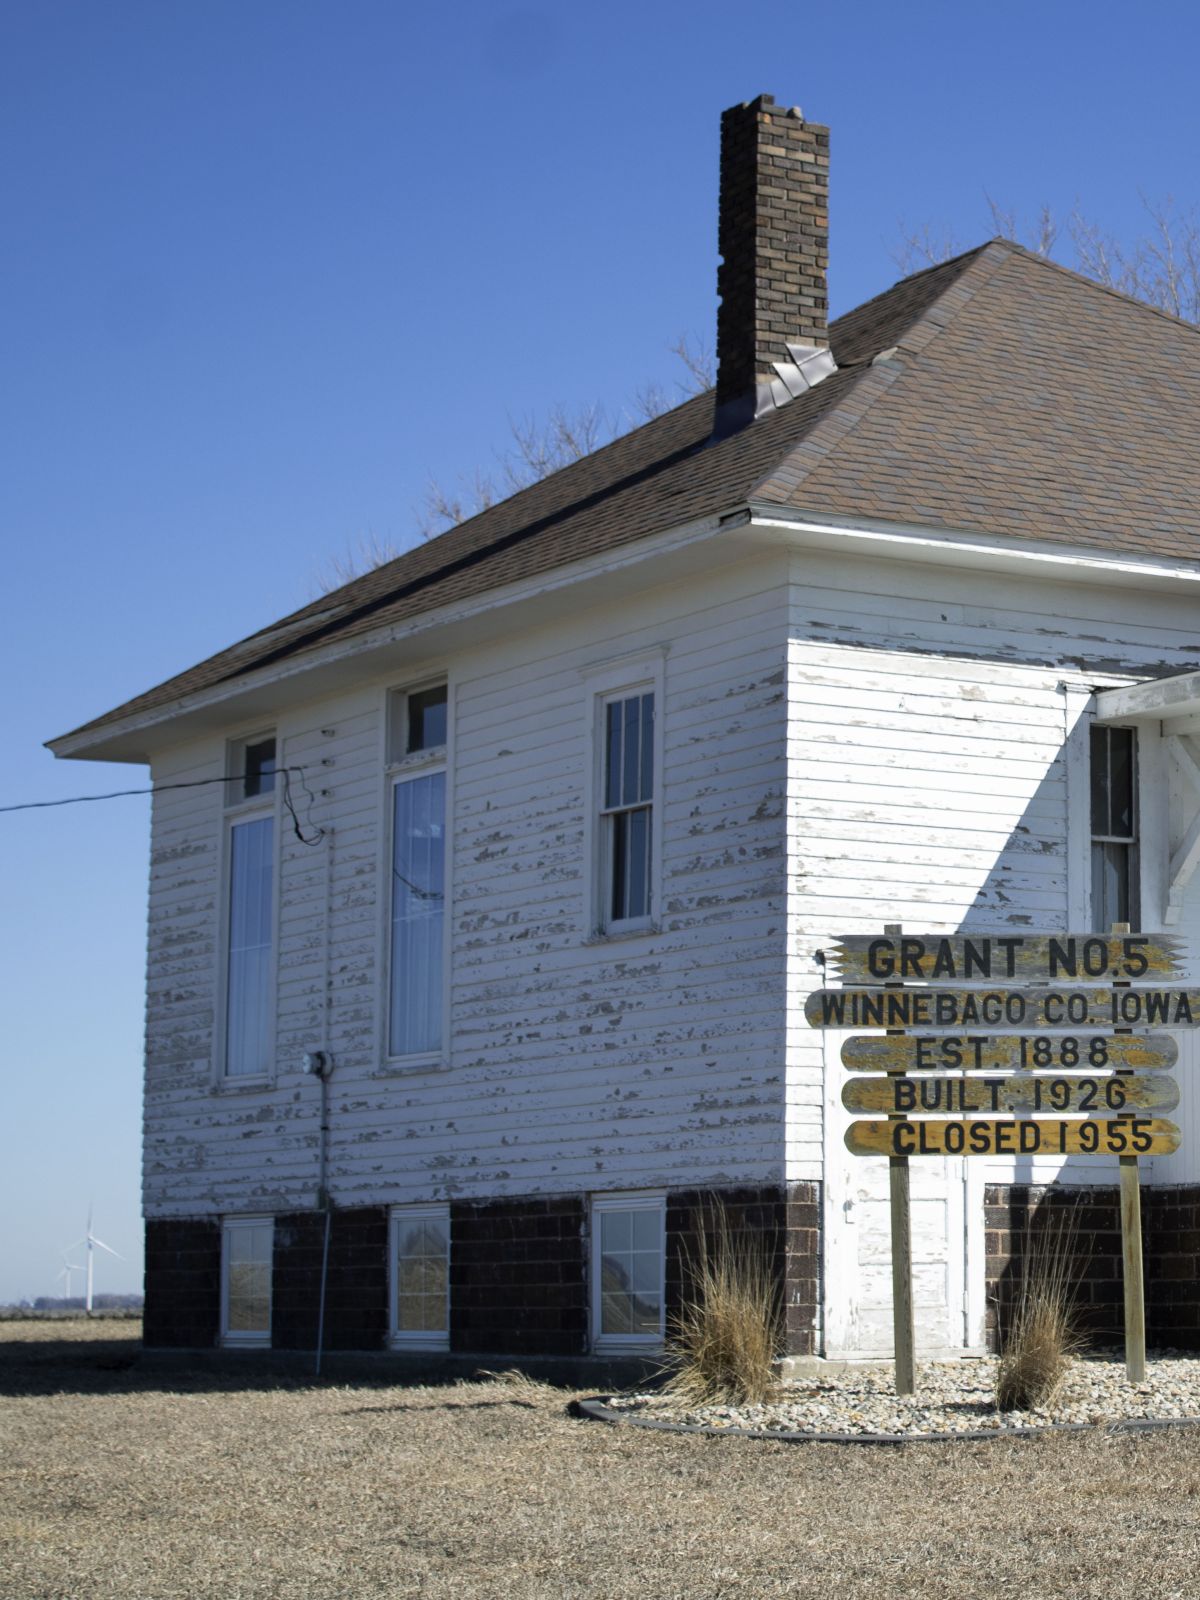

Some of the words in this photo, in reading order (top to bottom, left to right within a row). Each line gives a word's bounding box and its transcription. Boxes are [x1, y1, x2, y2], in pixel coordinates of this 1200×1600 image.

[868, 938, 1024, 979] GRANT
[821, 993, 1026, 1026] WINNEBAGO
[1044, 993, 1095, 1025] CO.
[1112, 992, 1193, 1024] IOWA
[916, 1037, 1000, 1069] EST.
[1020, 1036, 1109, 1068] 1888
[1034, 1078, 1126, 1111] 1926
[893, 1121, 1041, 1155] CLOSED
[1059, 1120, 1153, 1153] 1955
